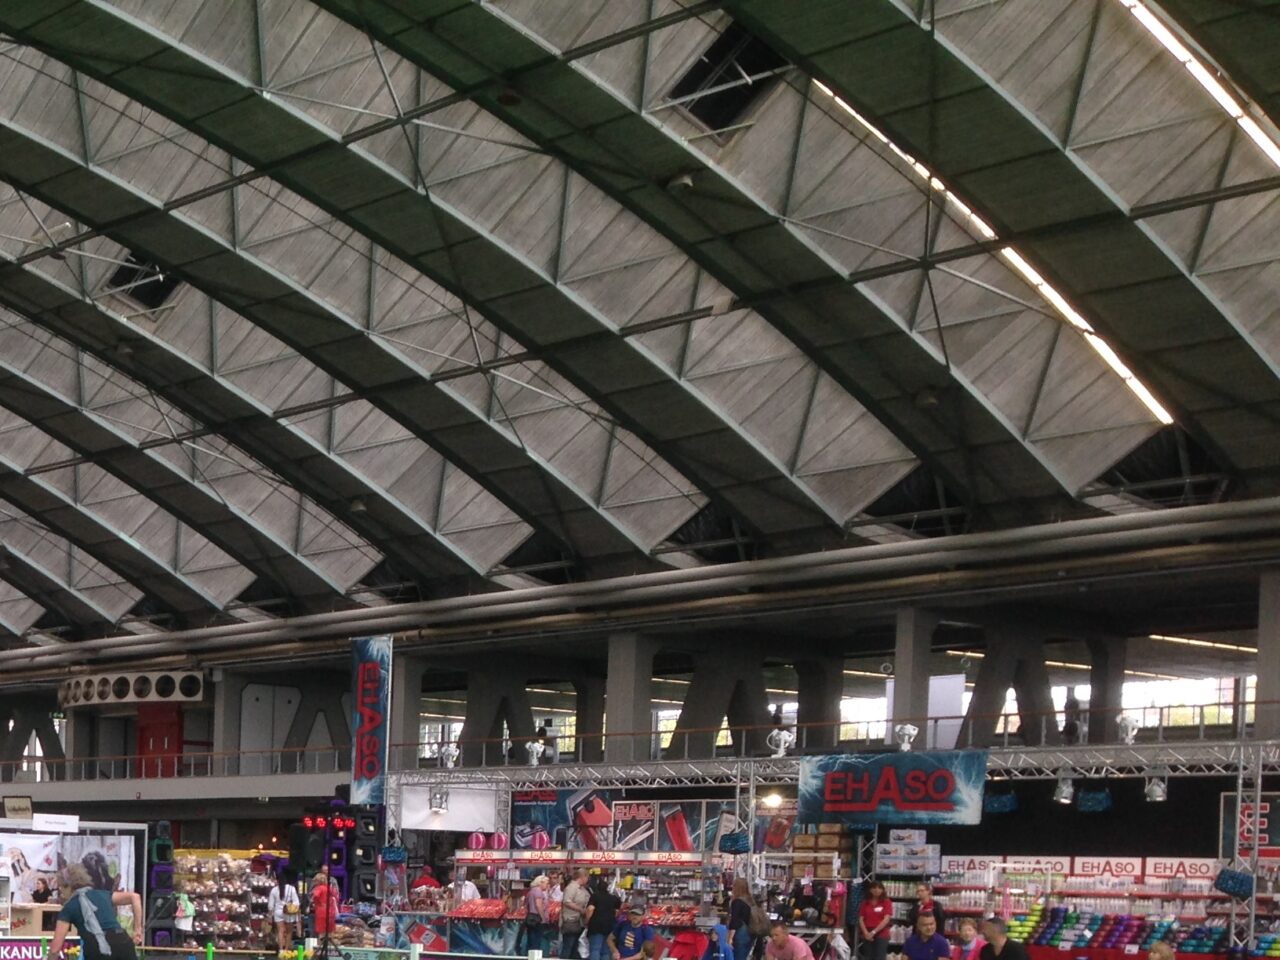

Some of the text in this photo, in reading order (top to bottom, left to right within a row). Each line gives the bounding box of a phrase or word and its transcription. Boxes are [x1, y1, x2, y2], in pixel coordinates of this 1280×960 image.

[357, 661, 382, 781] EHASO
[824, 765, 956, 809] EHASO
[614, 803, 655, 819] EHASO
[657, 852, 682, 861] EHASO
[1081, 859, 1135, 875] EHASO
[1153, 860, 1210, 876] EHASO
